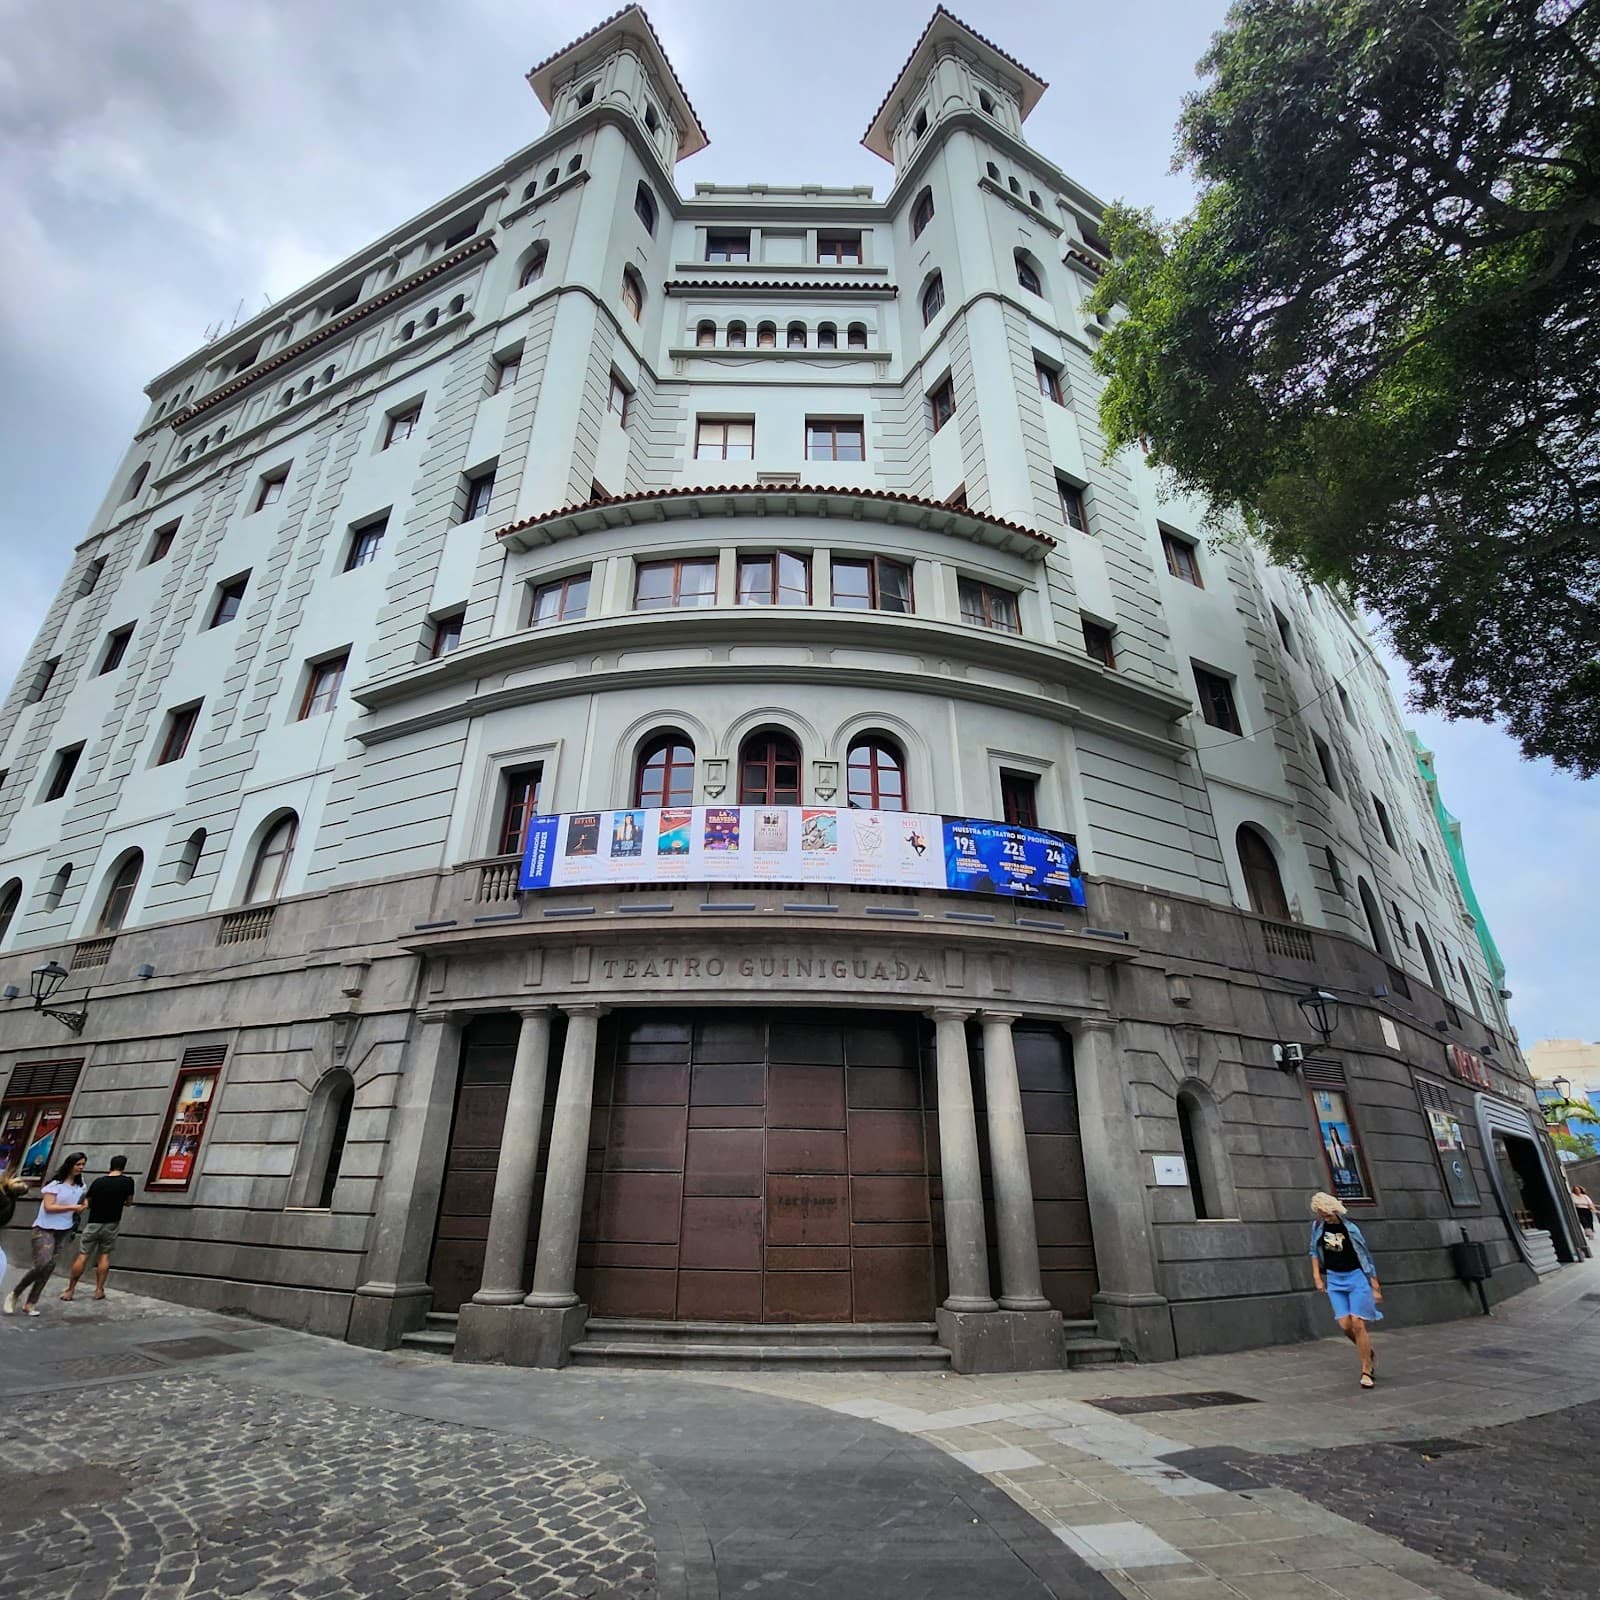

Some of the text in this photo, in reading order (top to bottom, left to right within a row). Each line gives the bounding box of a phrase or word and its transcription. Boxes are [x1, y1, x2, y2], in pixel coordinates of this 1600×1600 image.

[952, 826, 982, 834] MUESTRA
[992, 830, 1016, 839] TEATRO
[1028, 836, 1065, 848] PROFESIONAL
[954, 836, 969, 850] 19
[1002, 841, 1019, 855] 22
[1046, 849, 1061, 863] 24
[535, 854, 545, 876] JUNIO
[603, 958, 932, 982] TEATRO GUINIGUADA
